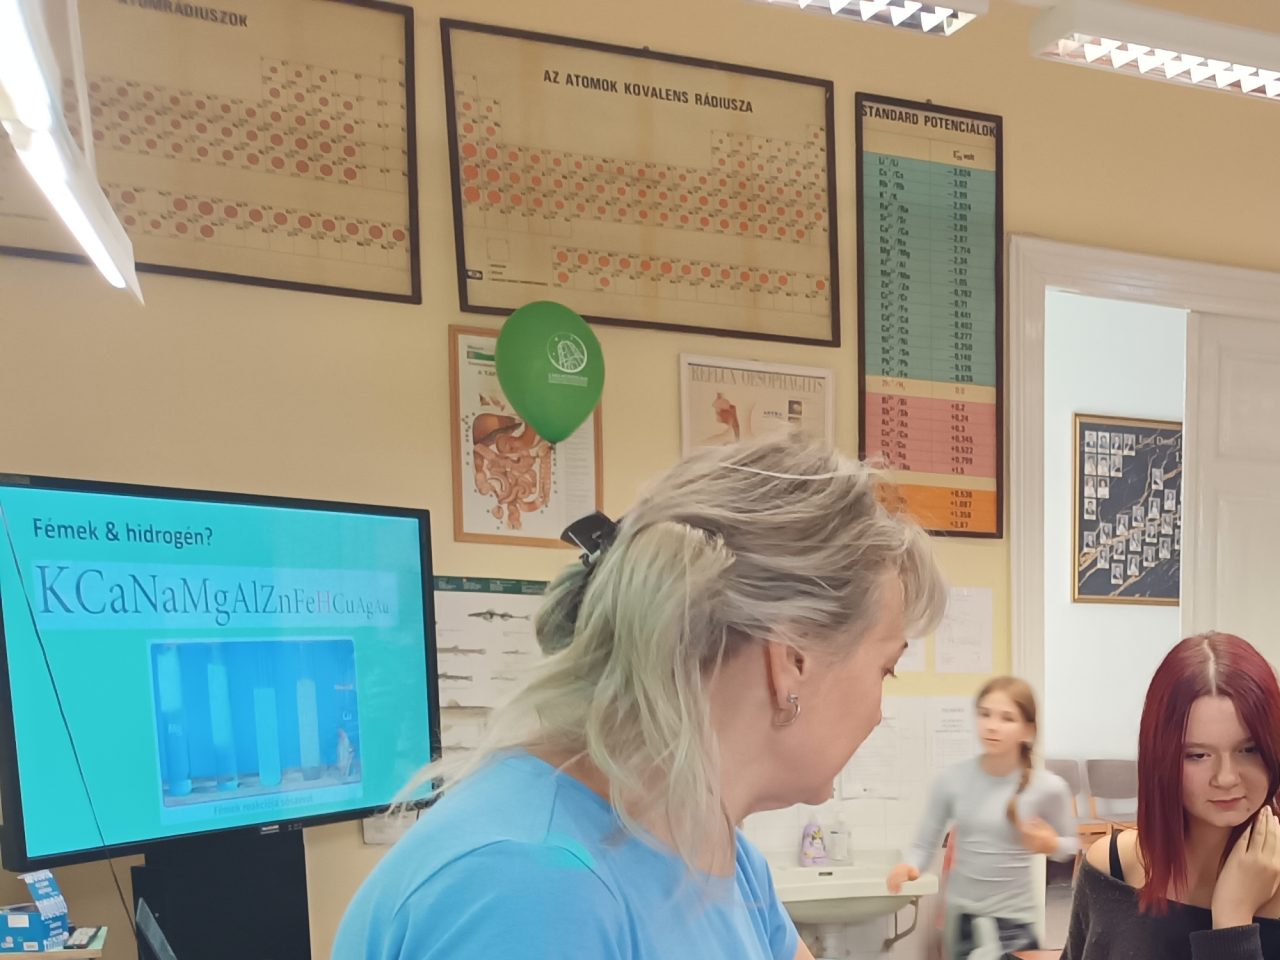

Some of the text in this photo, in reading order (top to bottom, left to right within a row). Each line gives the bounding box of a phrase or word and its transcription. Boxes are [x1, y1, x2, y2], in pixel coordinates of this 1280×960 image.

[543, 69, 754, 114] AZ ATOMOK KOVALENS RÁDIUSZA
[862, 104, 996, 138] STANDARD POTENCIÁLOK
[32, 517, 214, 549] Fémek & hidrogén?
